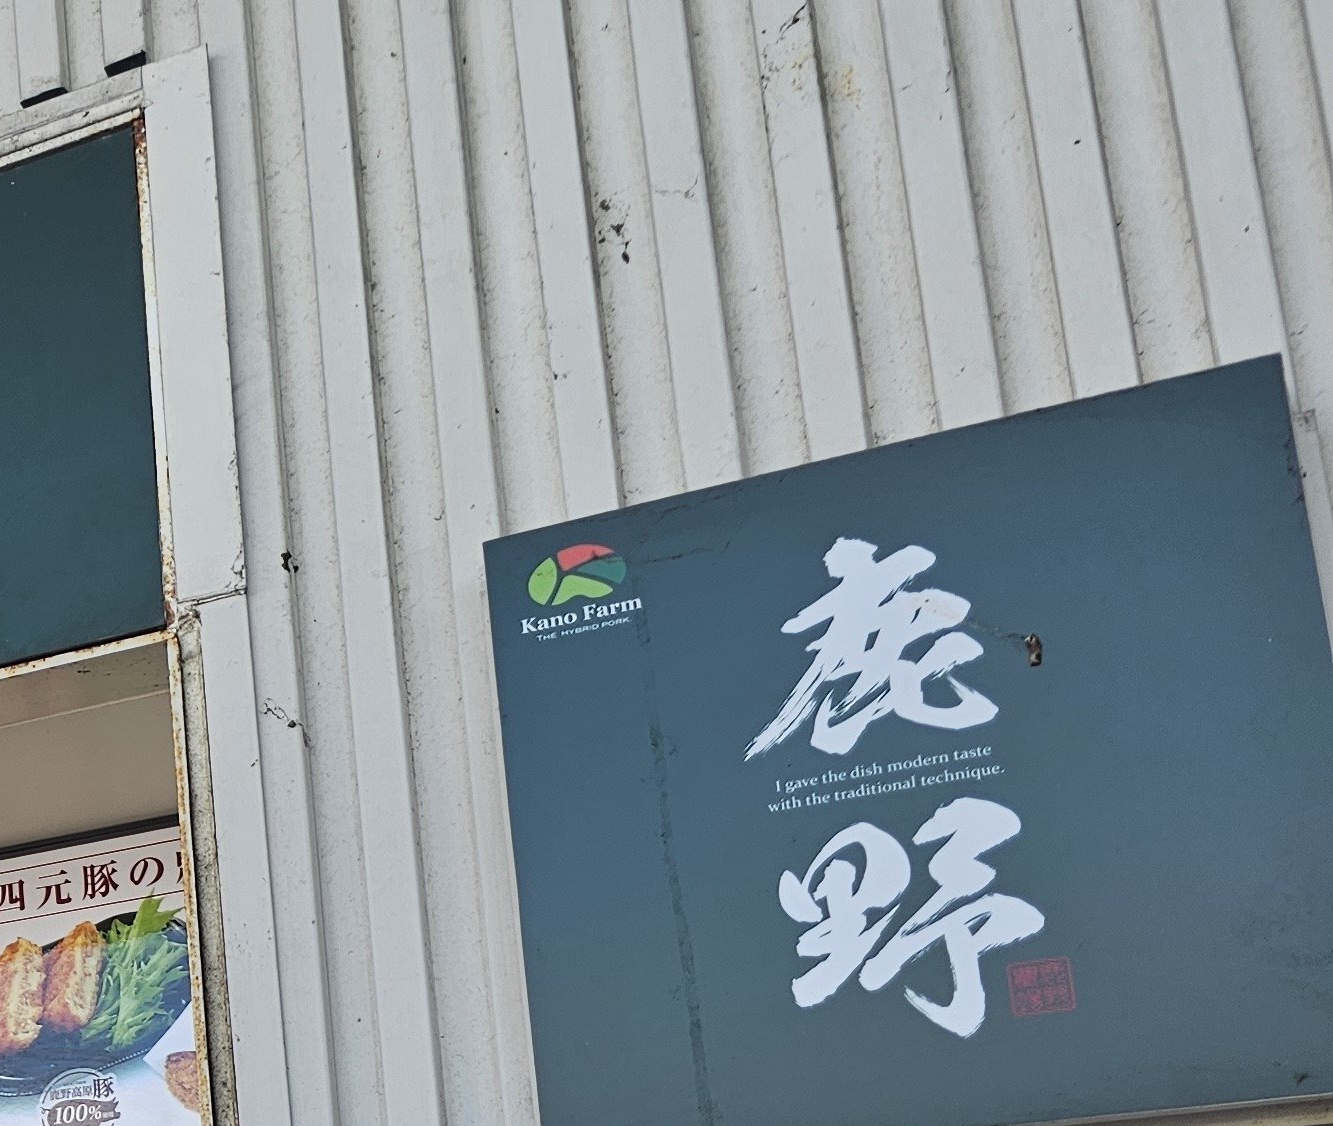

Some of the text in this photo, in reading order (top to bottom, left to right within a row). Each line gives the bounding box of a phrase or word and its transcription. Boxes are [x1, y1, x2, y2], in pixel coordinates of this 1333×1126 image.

[520, 598, 642, 634] Kano Farm
[767, 763, 1006, 813] with the traditional technique.
[785, 777, 818, 793] gave
[822, 770, 847, 784] the
[850, 763, 883, 779] dish
[887, 752, 949, 773] modern
[954, 745, 992, 761] taste
[54, 1104, 102, 1125] 100%
